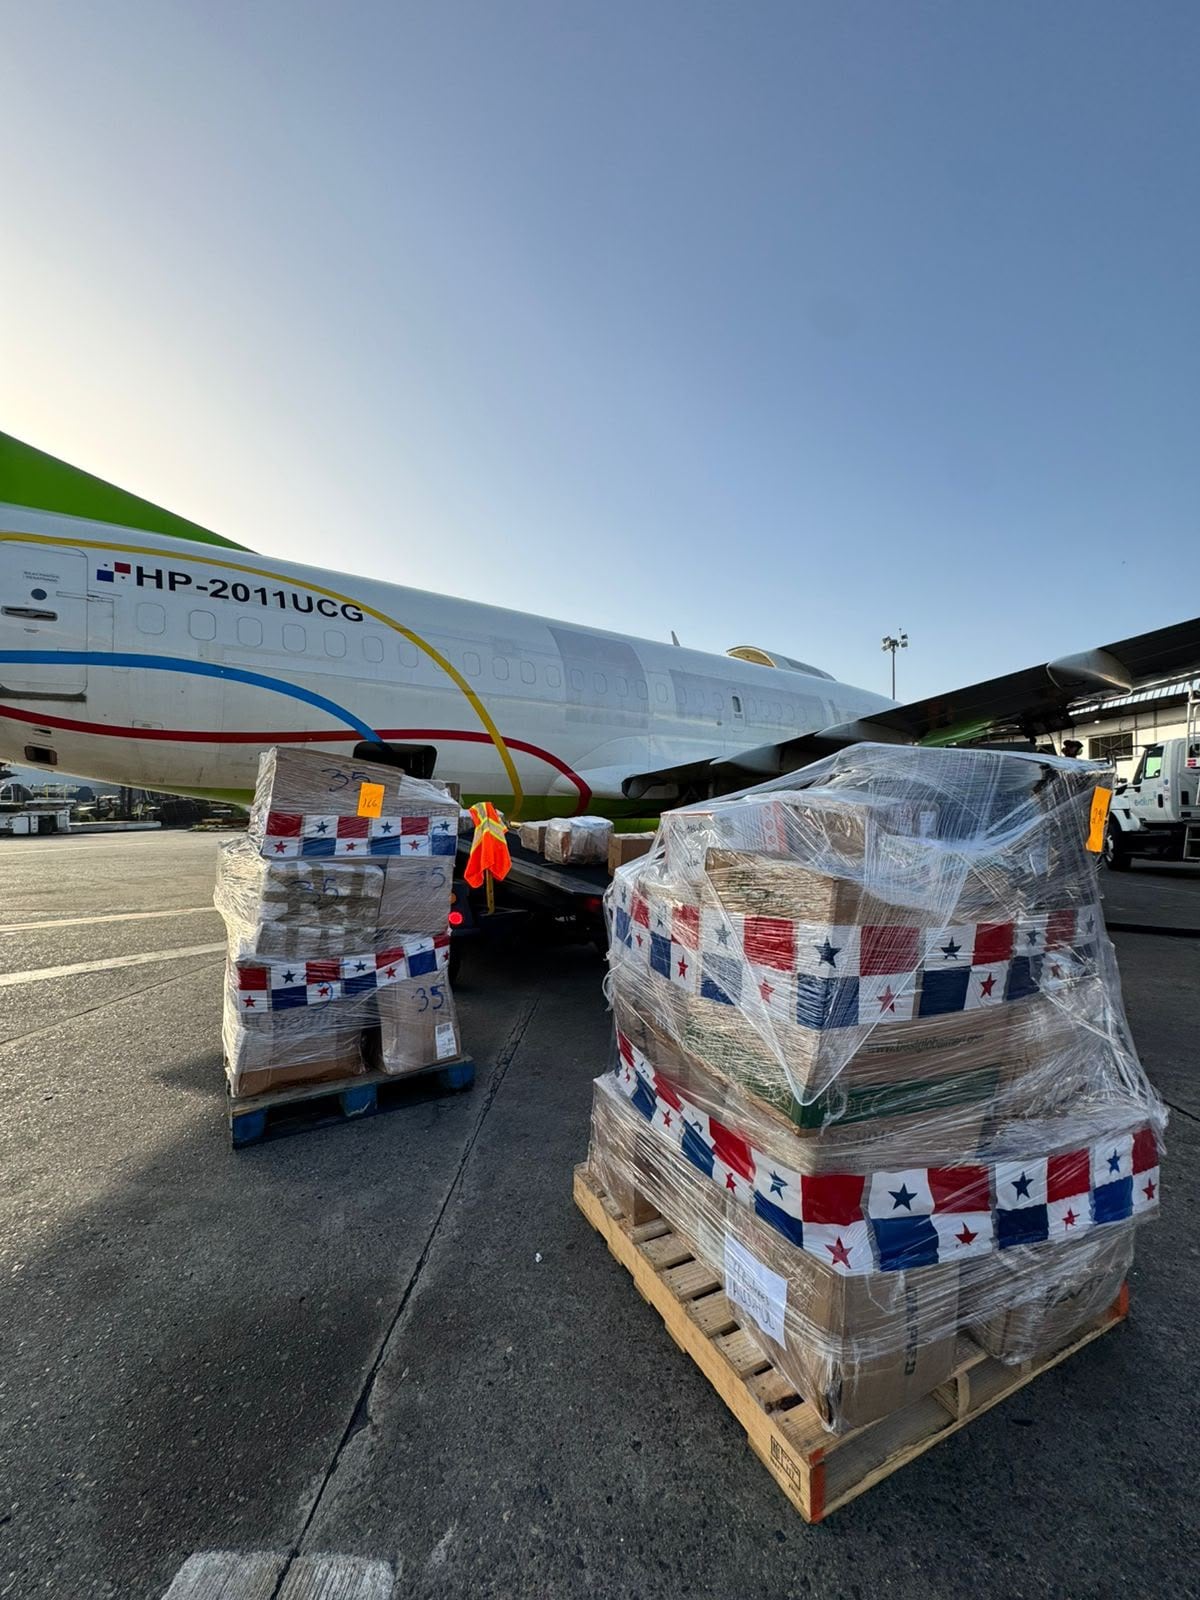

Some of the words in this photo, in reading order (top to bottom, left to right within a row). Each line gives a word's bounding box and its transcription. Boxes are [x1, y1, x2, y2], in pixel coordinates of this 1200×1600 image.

[136, 565, 364, 622] HP-2011UCG
[321, 768, 372, 793] 35
[290, 877, 340, 910] 35
[412, 982, 446, 1013] 35
